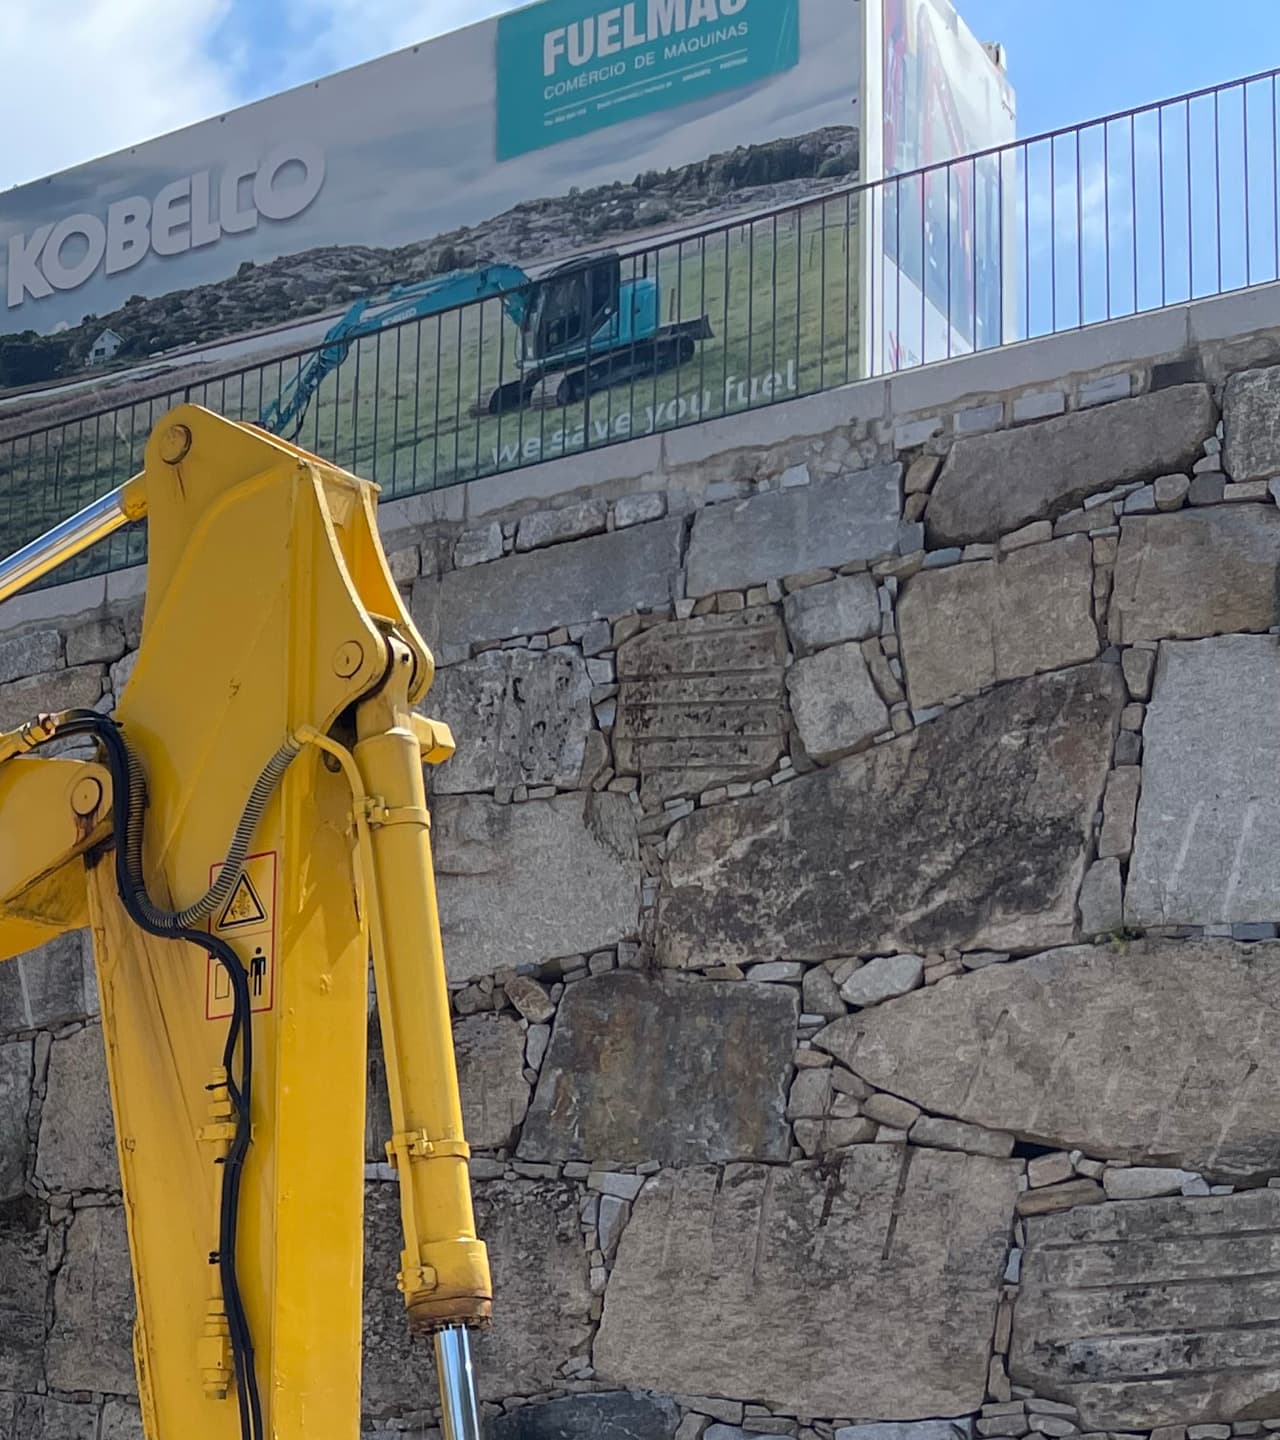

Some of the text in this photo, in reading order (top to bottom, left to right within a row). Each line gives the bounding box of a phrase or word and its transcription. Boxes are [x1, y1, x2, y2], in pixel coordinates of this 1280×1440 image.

[544, 62, 626, 100] COMÉRCIO
[634, 52, 656, 70] DE
[664, 21, 748, 60] MÁQUINAS
[7, 147, 326, 308] KOBELCO
[491, 359, 797, 465] we save you fuel
